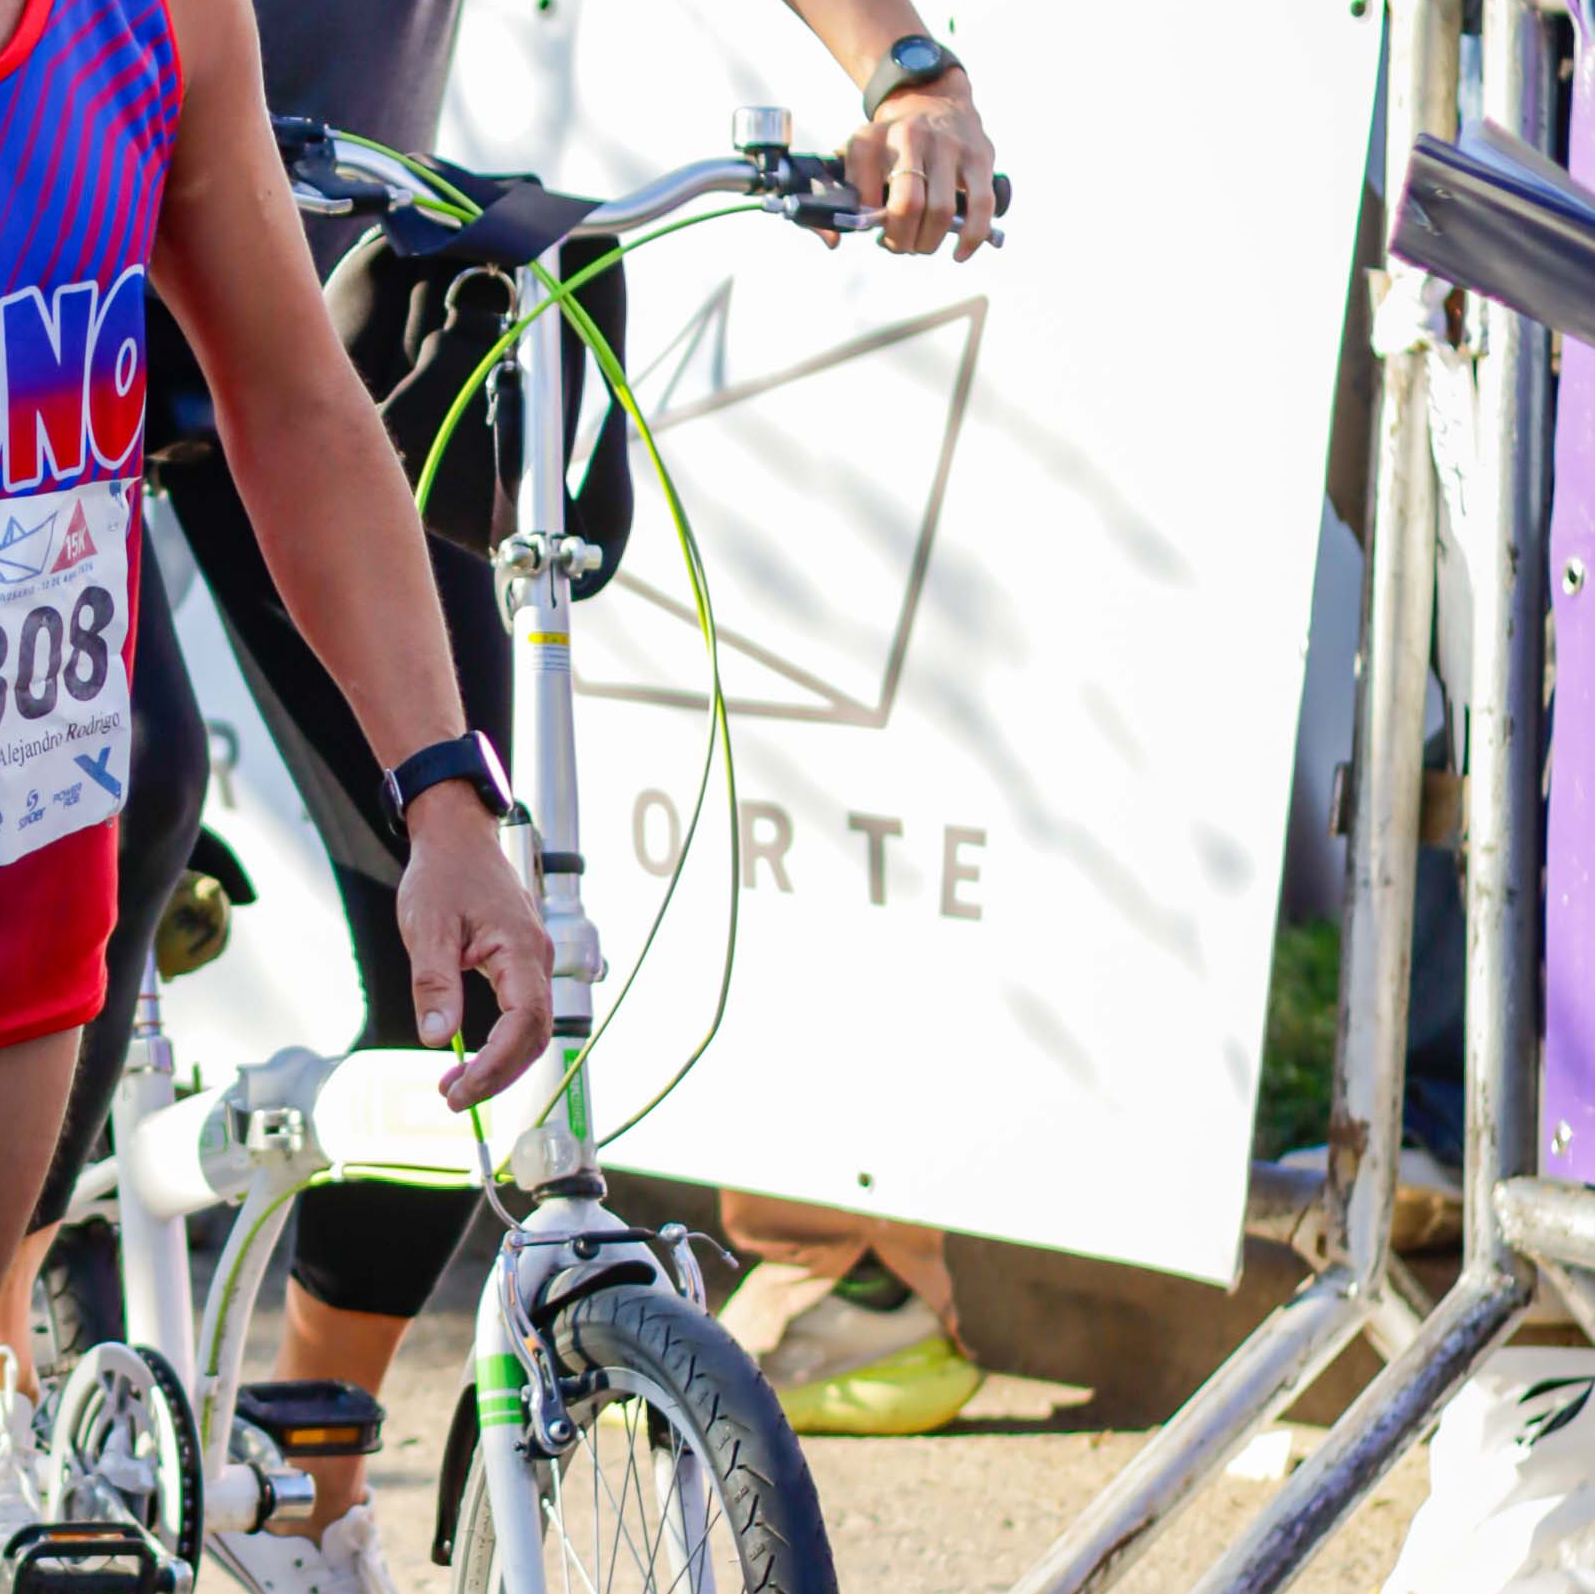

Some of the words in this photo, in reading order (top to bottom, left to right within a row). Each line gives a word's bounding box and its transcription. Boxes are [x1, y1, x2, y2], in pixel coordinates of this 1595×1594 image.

[64, 530, 87, 558] 15K
[65, 710, 121, 744] Rodrigo
[632, 787, 987, 921] ORTE
